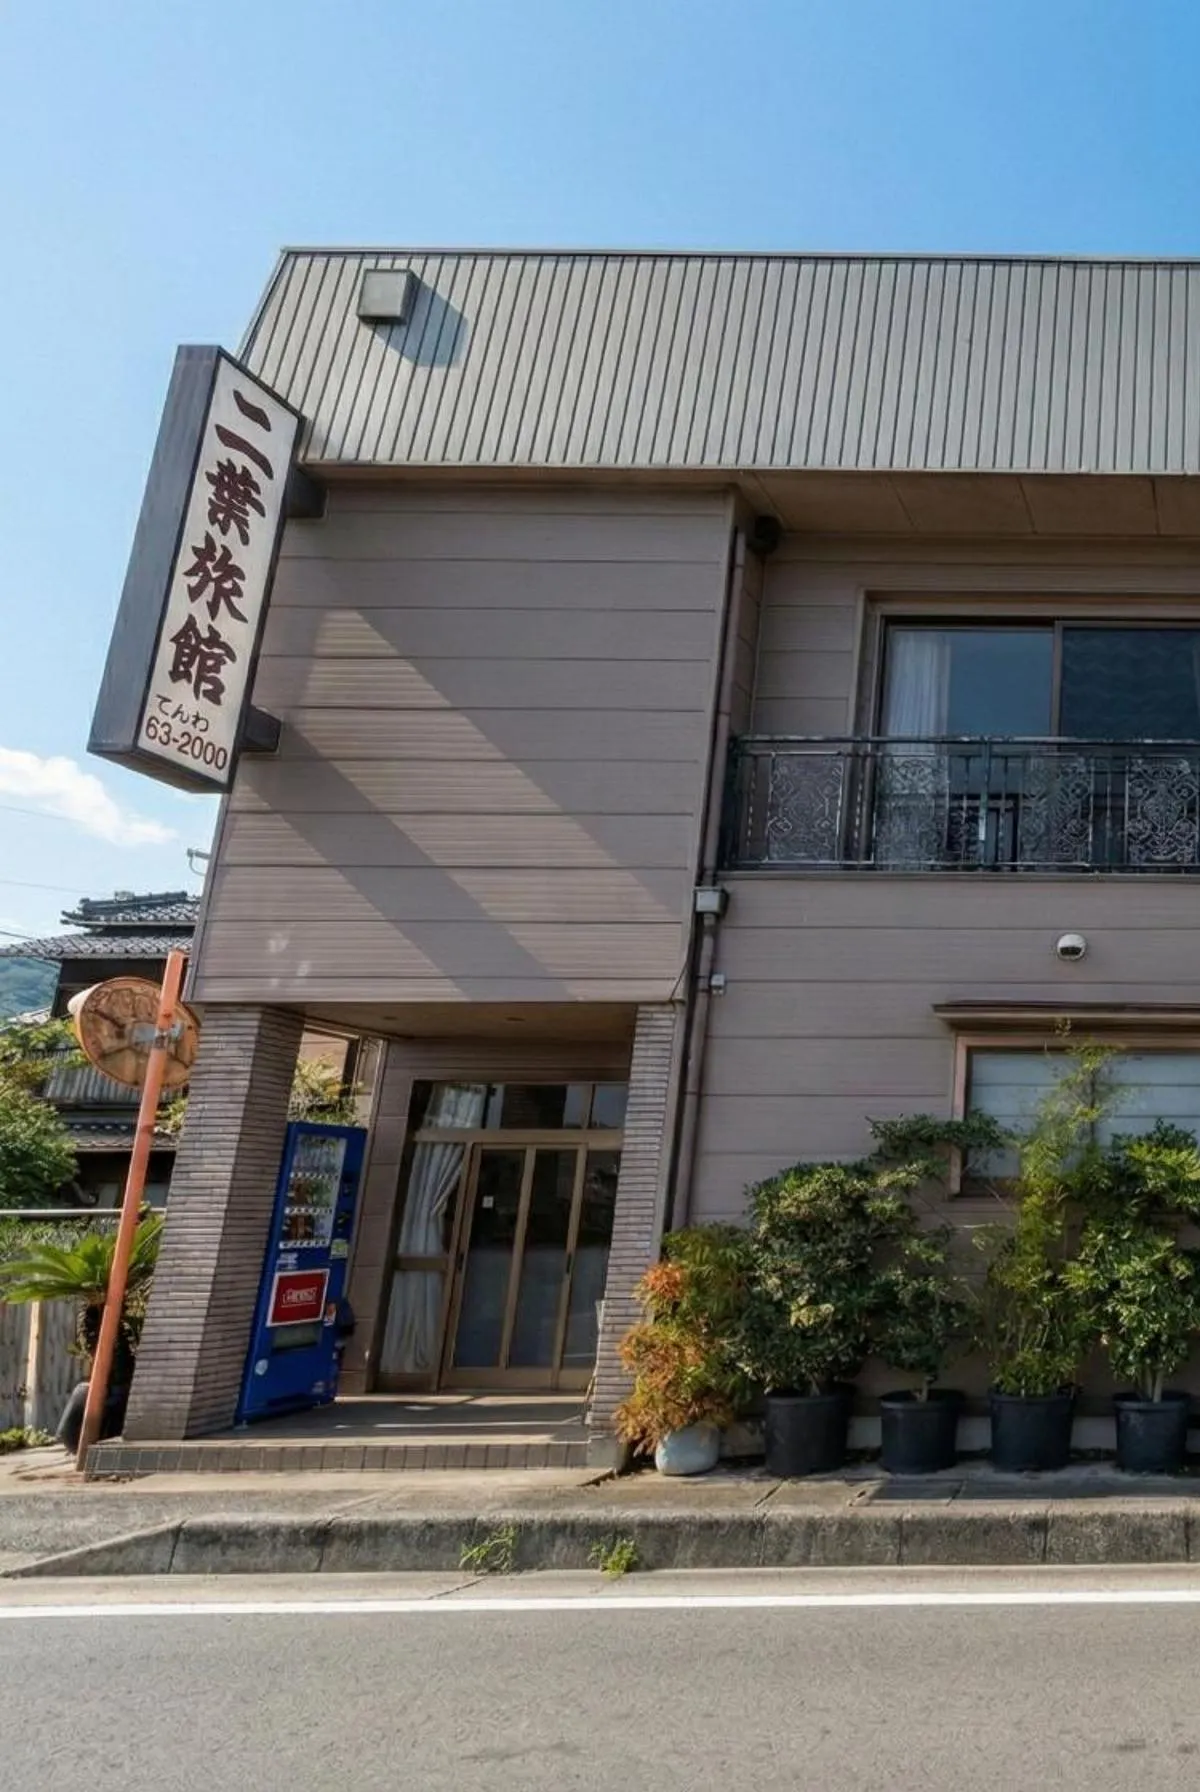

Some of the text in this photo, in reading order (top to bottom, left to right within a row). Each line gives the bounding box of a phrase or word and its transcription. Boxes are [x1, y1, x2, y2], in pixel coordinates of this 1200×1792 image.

[168, 389, 274, 706] 二葉旅館
[145, 715, 228, 771] 63-2000
